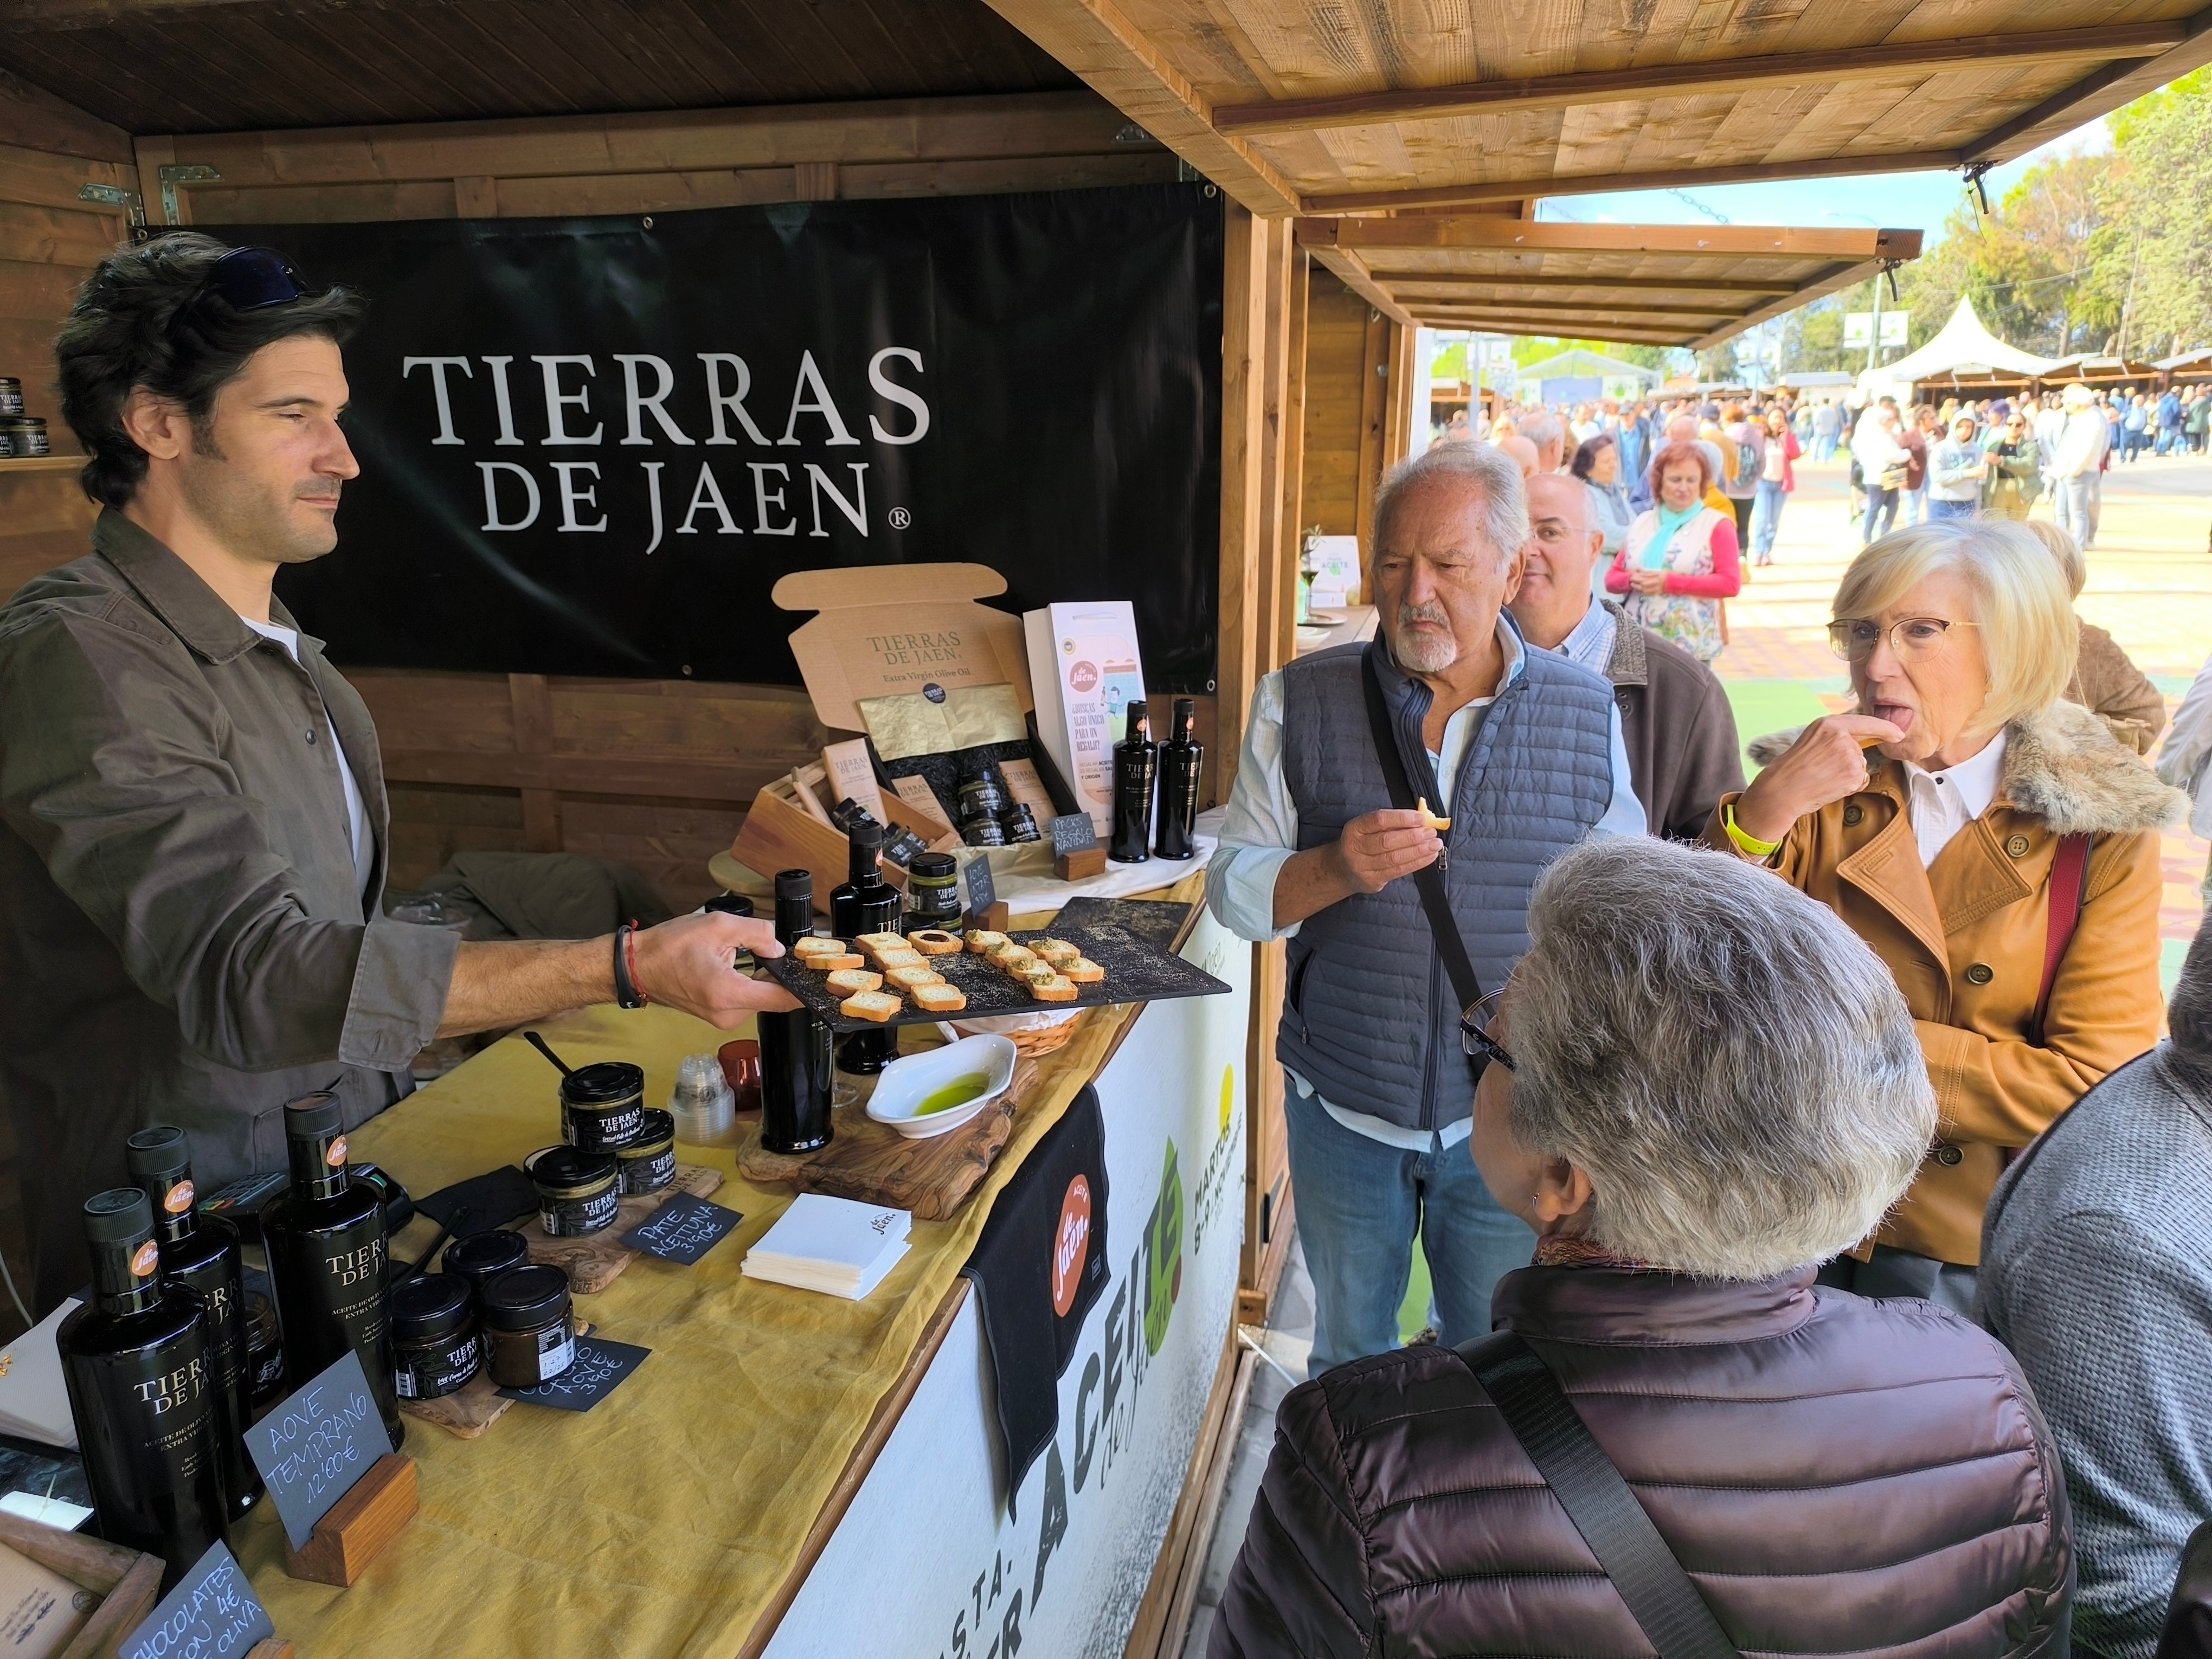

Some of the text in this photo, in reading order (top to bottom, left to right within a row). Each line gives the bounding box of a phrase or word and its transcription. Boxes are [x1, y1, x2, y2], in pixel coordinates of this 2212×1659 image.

[403, 346, 930, 446] TIERRAS
[474, 461, 608, 532] DE
[866, 631, 961, 652] TIERRAS
[883, 651, 910, 665] DE
[883, 667, 970, 683] Extra Virgin Olive Oil
[1072, 703, 1096, 715] ¿BUSCAS
[1073, 715, 1088, 727] ALGO
[1075, 727, 1098, 740] PARA UN
[1076, 740, 1100, 752] REGALO?
[834, 756, 868, 769] TIERRAS
[1054, 817, 1083, 830] PACKS
[1054, 828, 1093, 841] REGALO
[1056, 835, 1094, 851] NAVIDAD
[599, 1108, 640, 1127] TIERRAS
[605, 1116, 638, 1133] DE JAEN
[656, 1163, 666, 1174] DE
[1194, 1112, 1231, 1221] MARTOS
[664, 1165, 705, 1192] TIERRAS
[678, 1182, 692, 1191] DE
[582, 1186, 617, 1212] TIERRAS
[1073, 1184, 1088, 1204] ACEITE
[589, 1206, 601, 1217] DE
[638, 1209, 685, 1240] PATE
[651, 1205, 719, 1257] ACEITUNA
[1063, 1211, 1074, 1244] de
[342, 1263, 370, 1287] DE
[331, 1303, 358, 1316] ACEITE
[358, 1298, 368, 1308] DE
[345, 1307, 369, 1320] EXTRA
[454, 1356, 467, 1367] DE
[1029, 1147, 1178, 1621] ACEITE
[153, 1387, 189, 1415] DE
[269, 1386, 325, 1455] AOVE
[266, 1392, 367, 1494] TEMPRANO
[1101, 1402, 1124, 1490] de
[307, 1435, 361, 1504] 12'00€
[217, 1583, 240, 1615] 4€
